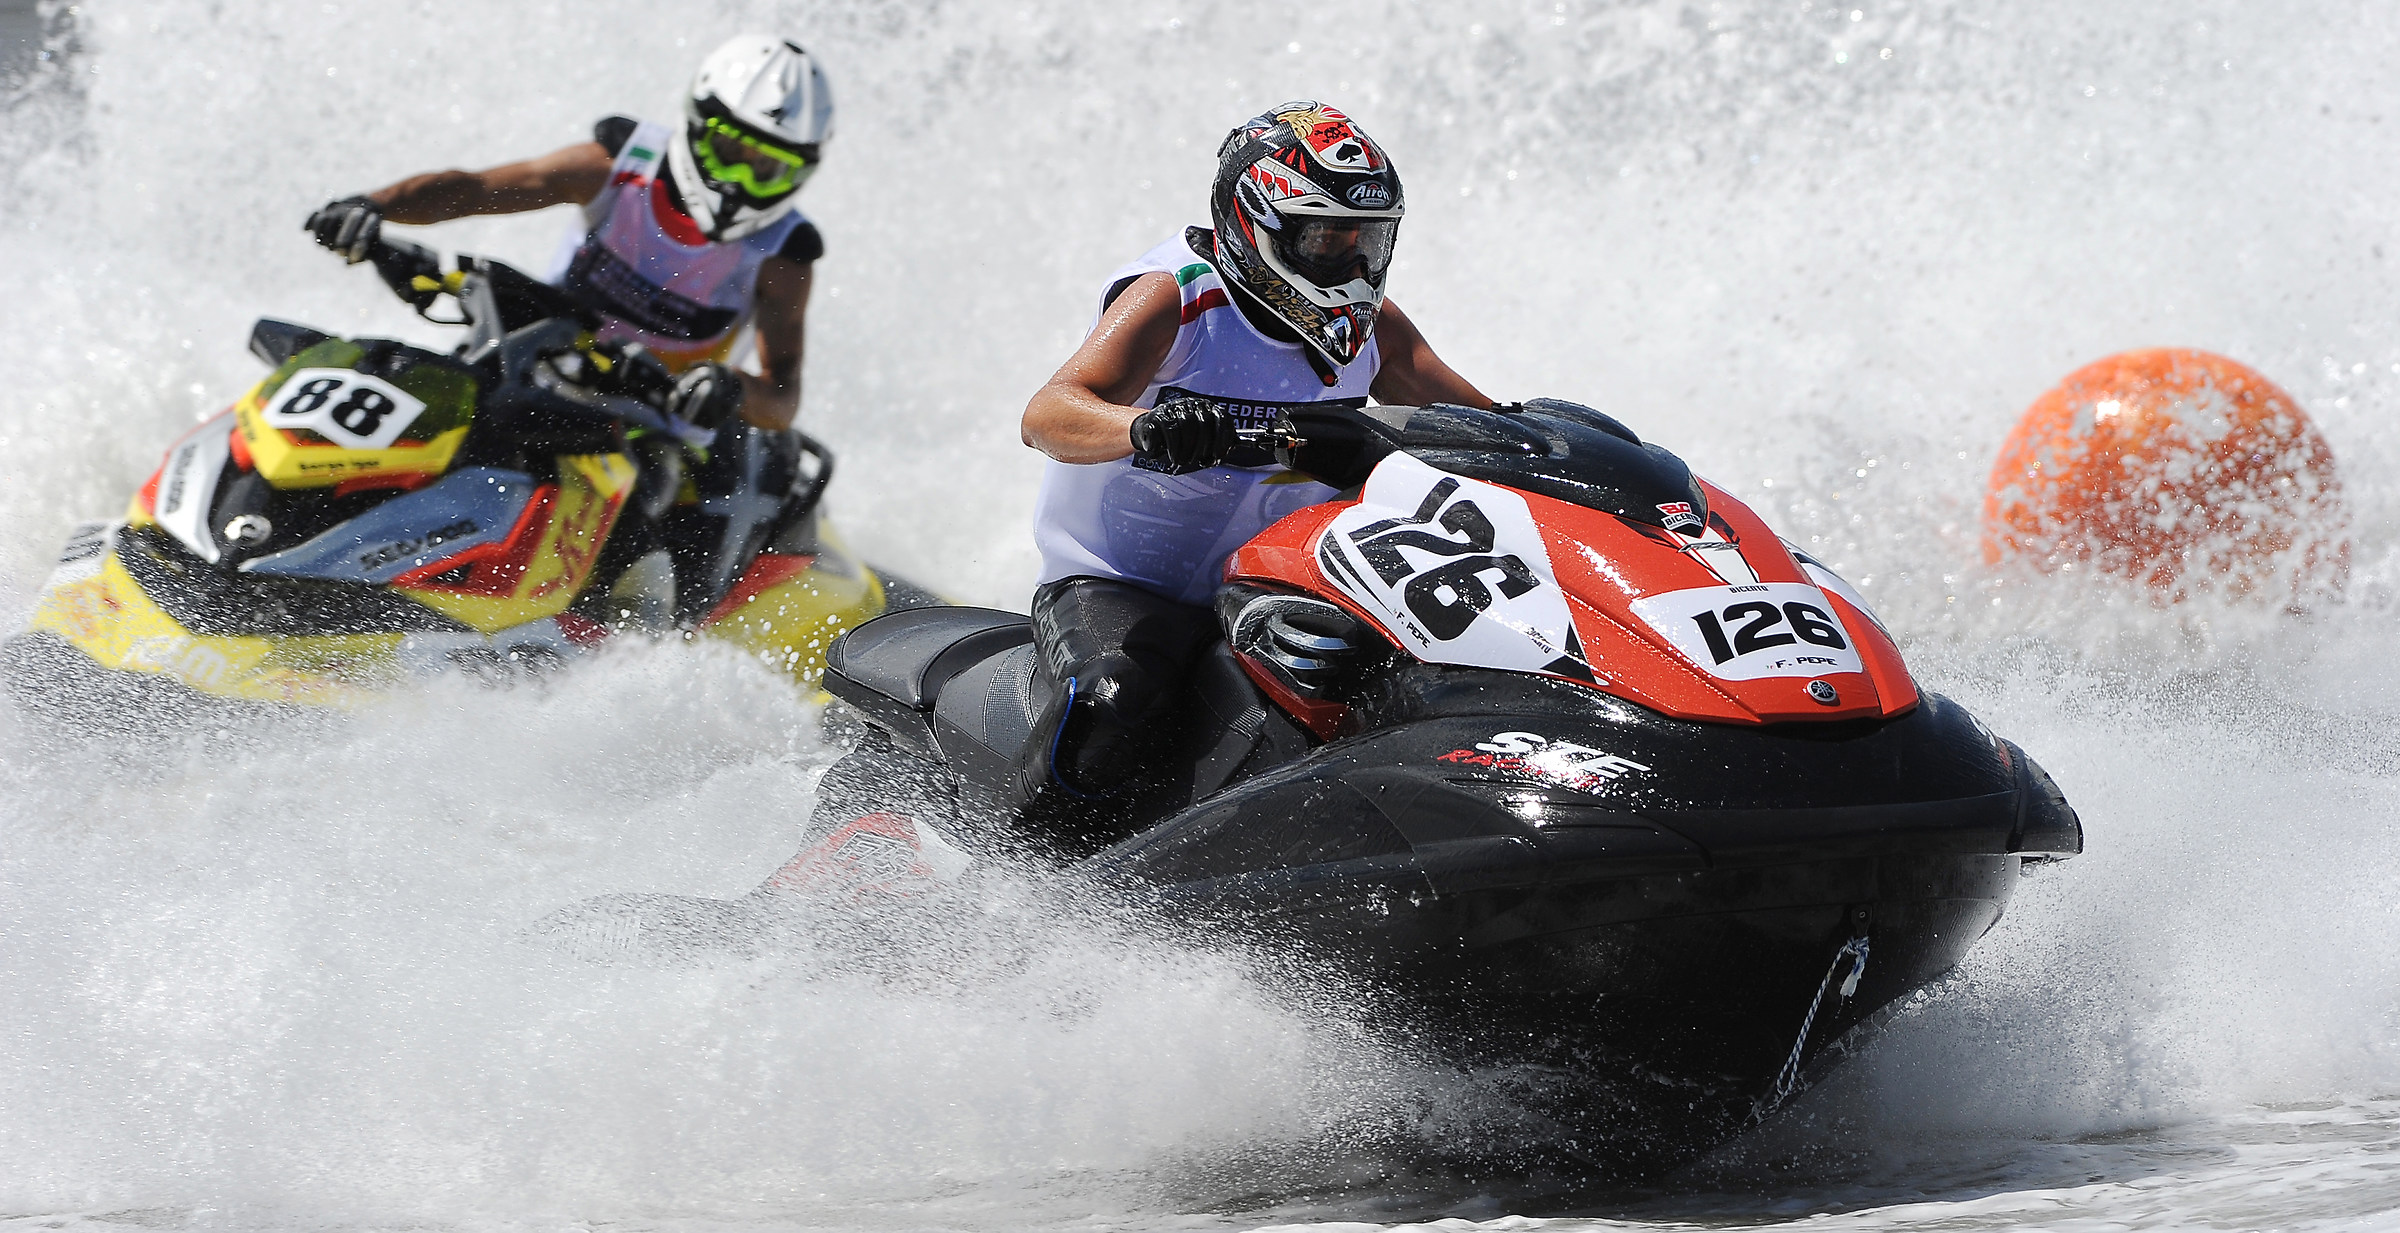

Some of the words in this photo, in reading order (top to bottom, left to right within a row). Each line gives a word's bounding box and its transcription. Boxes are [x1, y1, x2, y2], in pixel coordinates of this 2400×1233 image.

[1351, 185, 1390, 201] Airoh
[280, 379, 396, 437] 88
[1347, 476, 1541, 641] 126
[1396, 611, 1406, 625] F.
[1405, 620, 1432, 649] PEPE
[1690, 600, 1847, 666] 126
[1775, 660, 1793, 669] F.
[1795, 656, 1838, 666] PEPE
